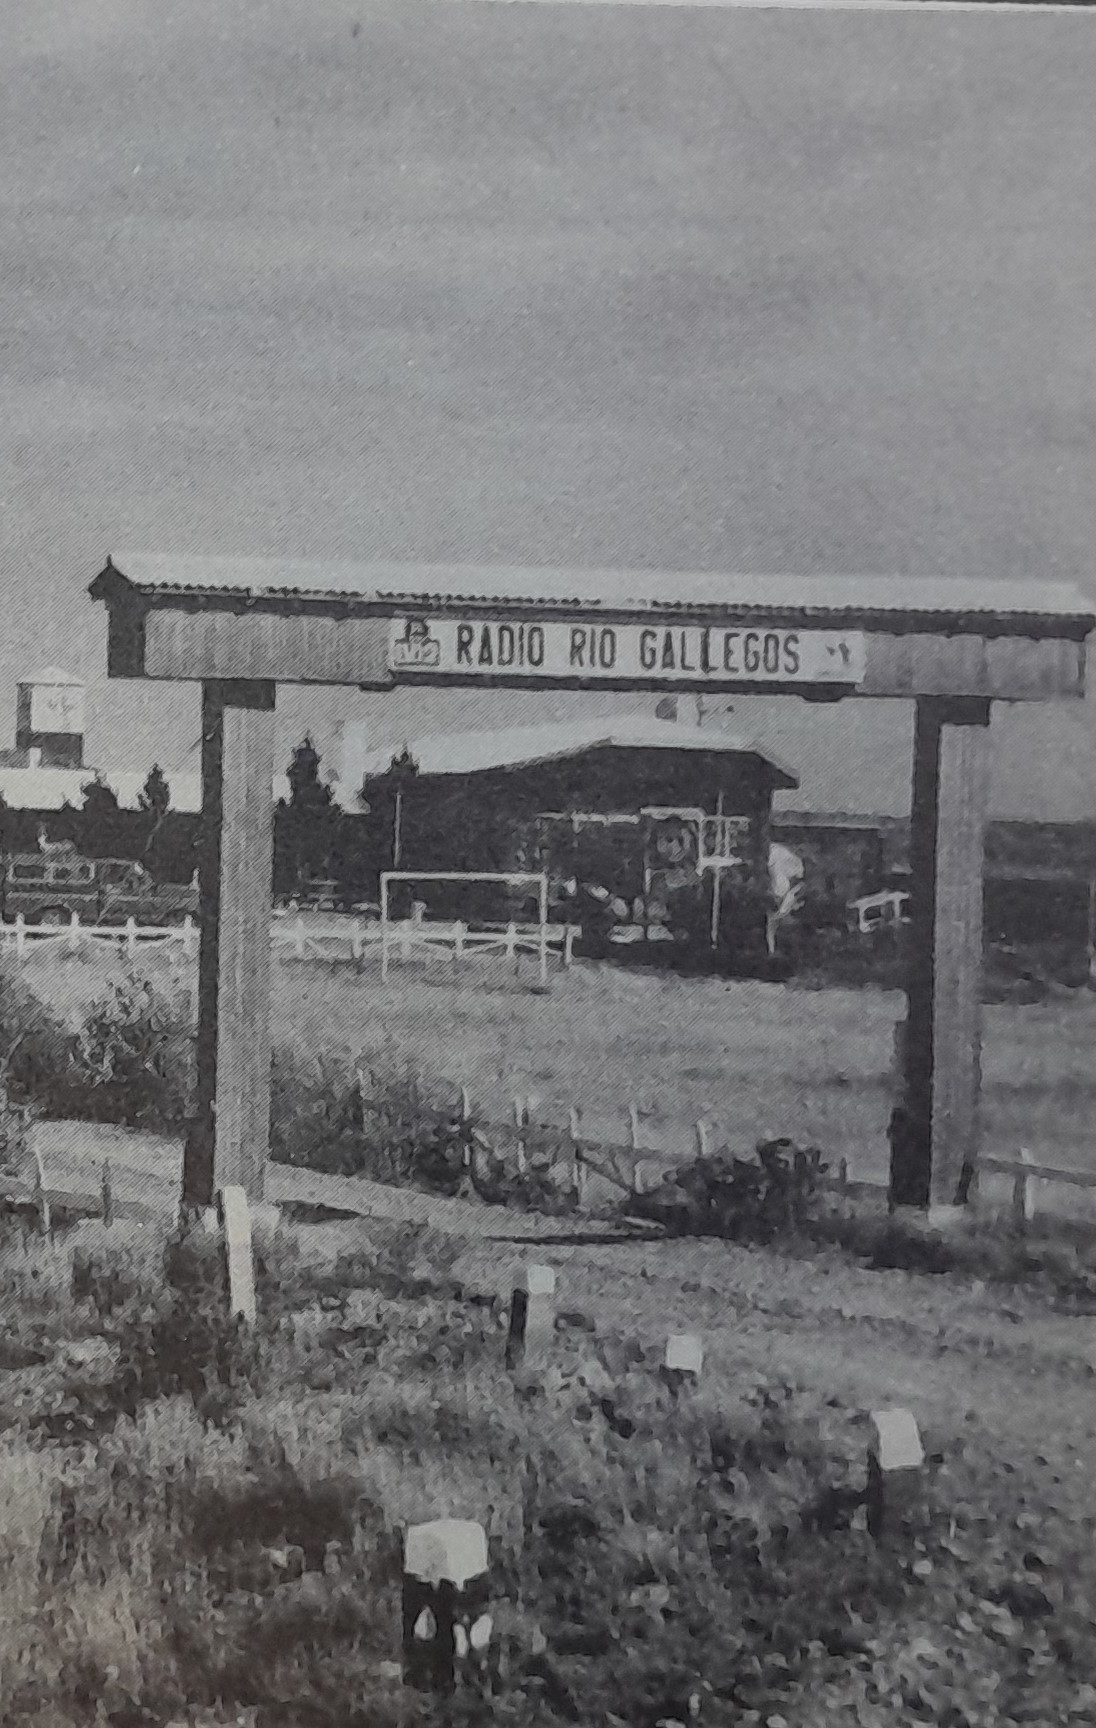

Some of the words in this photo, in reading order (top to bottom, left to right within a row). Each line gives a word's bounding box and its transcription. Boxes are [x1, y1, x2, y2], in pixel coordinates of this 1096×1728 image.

[457, 622, 544, 667] RADIO
[570, 628, 616, 668] RIO
[640, 628, 799, 675] GALLEGOS
